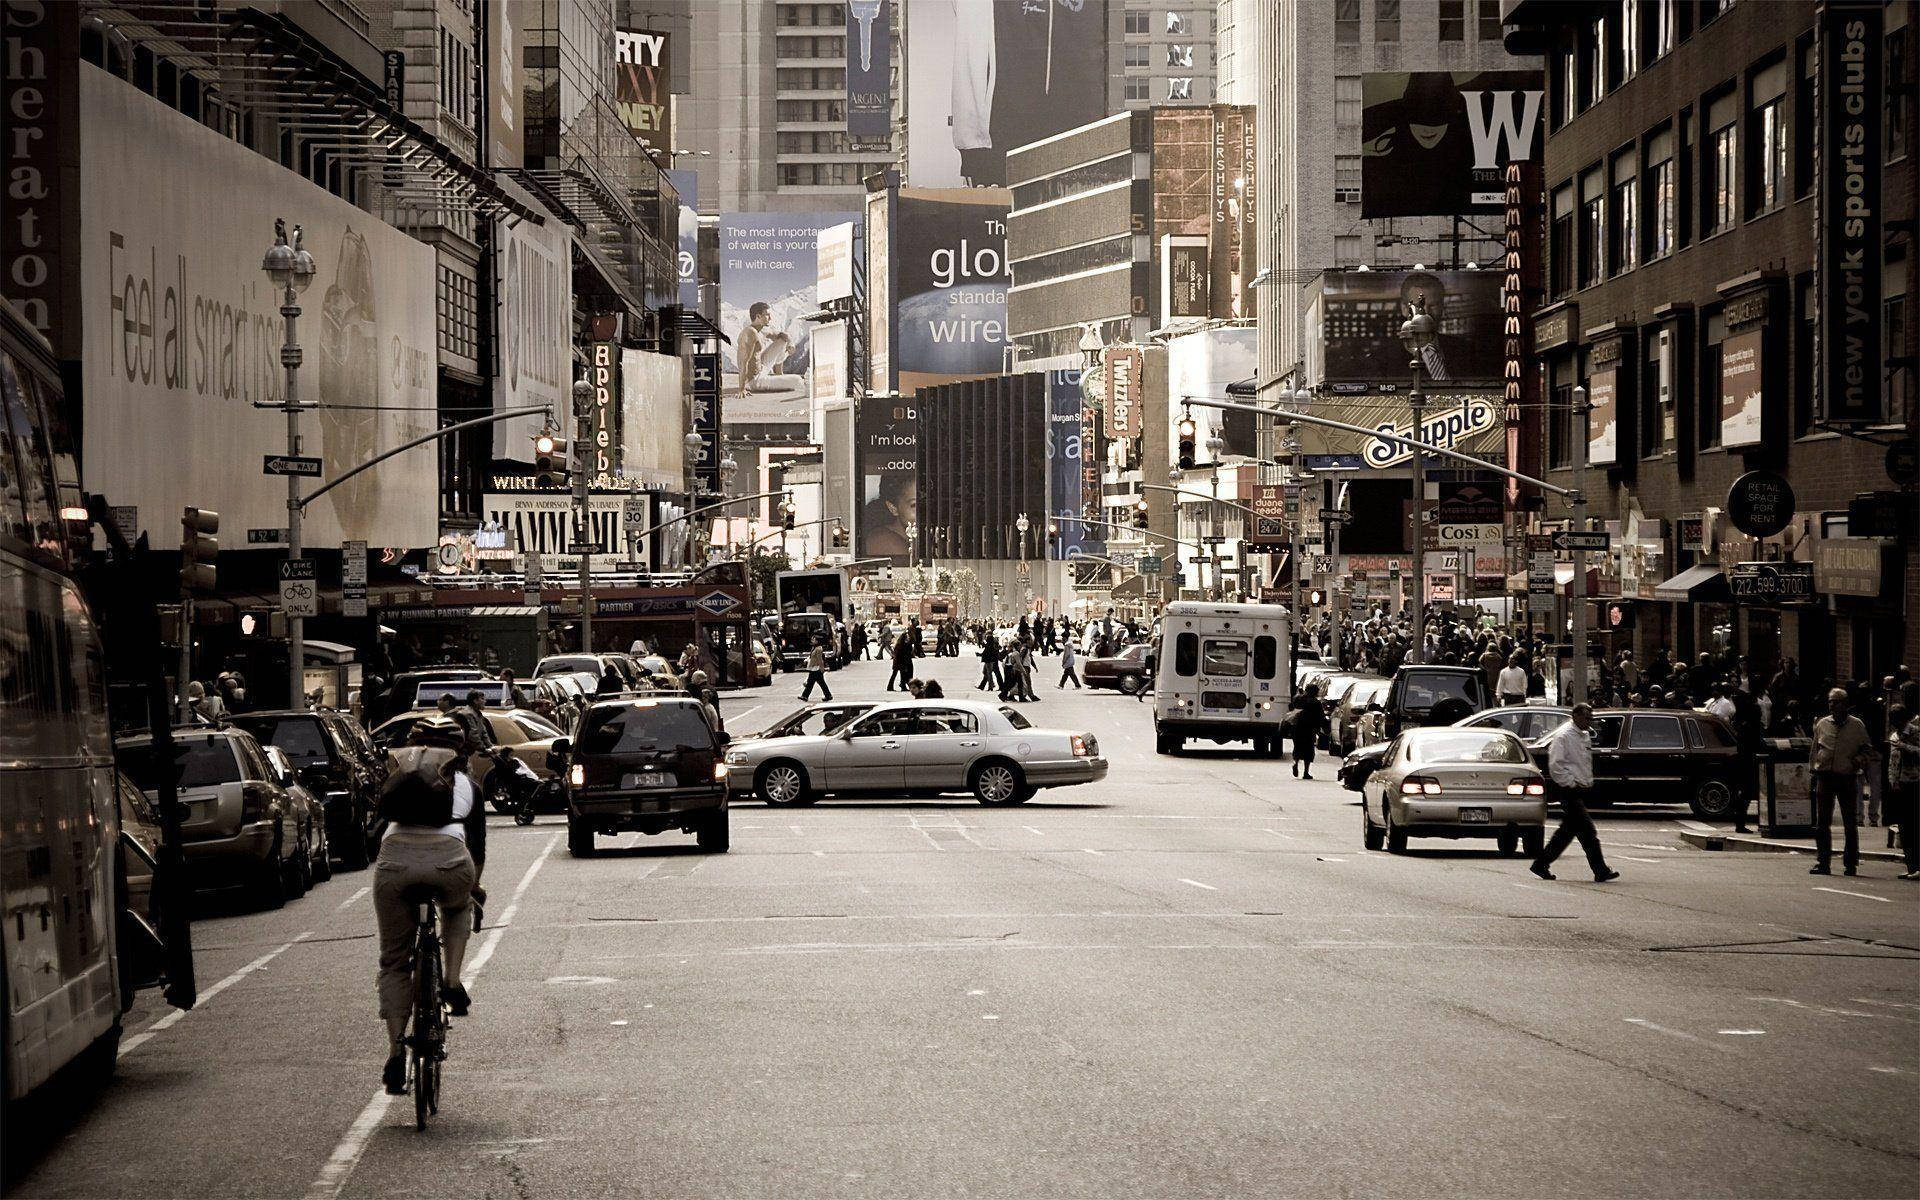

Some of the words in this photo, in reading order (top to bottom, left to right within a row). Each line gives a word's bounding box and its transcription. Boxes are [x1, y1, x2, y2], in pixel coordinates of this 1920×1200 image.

[1840, 20, 1866, 117] clubs
[617, 101, 664, 131] NEY
[1216, 121, 1224, 222] HERSHEYS
[1245, 123, 1254, 223] HERSHEYS
[1841, 121, 1871, 238] sports
[985, 220, 1006, 235] Th
[727, 228, 747, 237] The
[749, 228, 776, 237] most
[779, 228, 828, 239] importa
[728, 241, 739, 250] of
[741, 242, 770, 250] water
[774, 241, 782, 250] is
[785, 242, 808, 252] your
[729, 260, 742, 269] Fill
[746, 260, 767, 269] with
[769, 260, 795, 269] care.
[1841, 247, 1870, 326] york
[950, 290, 1007, 304] standa
[110, 231, 156, 385] Feel
[164, 254, 188, 390] all
[194, 284, 248, 401] smart
[1843, 328, 1865, 408] new
[1113, 356, 1133, 430] Twizzlers
[1052, 413, 1071, 423] Morgan
[1073, 412, 1080, 421] S
[871, 434, 890, 445] I'm
[272, 461, 289, 470] ONE
[296, 463, 314, 471] WAY
[1748, 482, 1779, 492] RETAIL
[1255, 498, 1283, 507] duane
[1748, 493, 1780, 503] SPACE
[1256, 506, 1282, 515] reade
[1753, 504, 1774, 512] FOR
[625, 512, 642, 522] 30
[1750, 514, 1776, 523] RENT
[259, 530, 269, 542] 52
[1442, 525, 1484, 540] Così
[1560, 537, 1577, 545] ONE
[1585, 537, 1603, 545] WAY
[288, 604, 309, 613] ONLY
[601, 603, 634, 613] PARTNER
[652, 600, 677, 608] asics
[1180, 607, 1198, 615] 3862
[391, 610, 400, 618] MY
[401, 609, 436, 618] RUNNING
[438, 608, 471, 617] PARTNER
